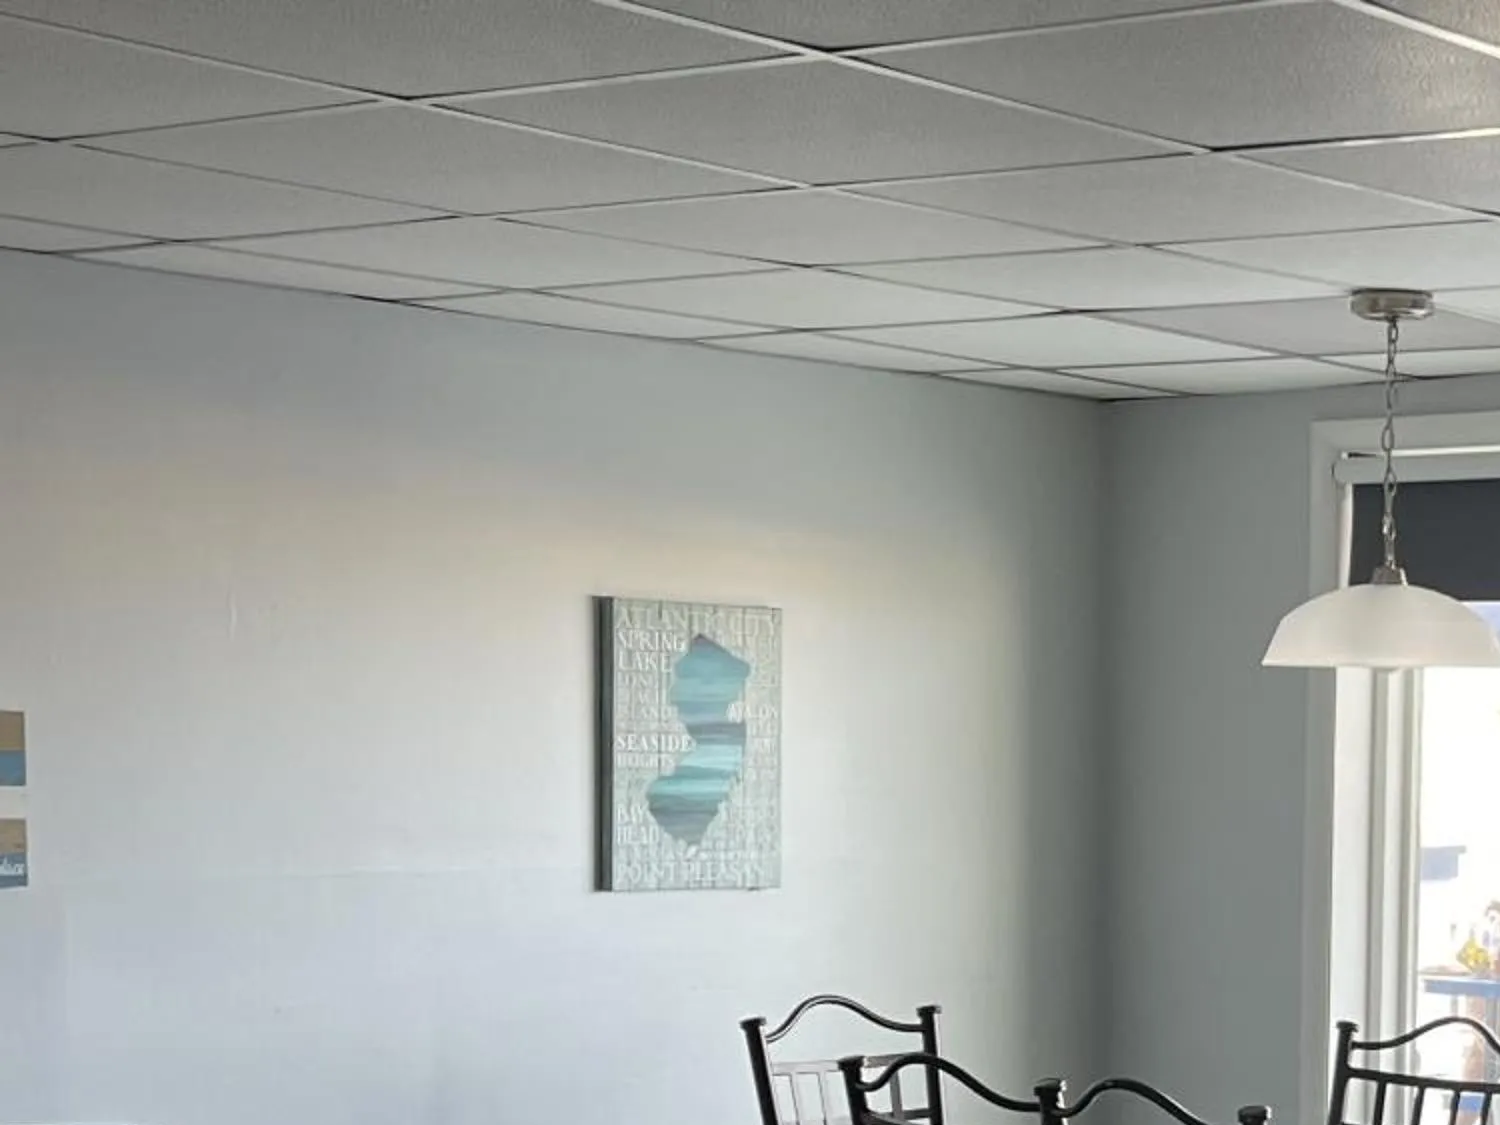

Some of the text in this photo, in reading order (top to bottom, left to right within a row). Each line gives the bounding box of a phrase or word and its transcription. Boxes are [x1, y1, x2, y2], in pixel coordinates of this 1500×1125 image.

[617, 630, 686, 652] SPRING
[618, 651, 672, 673] LAKE
[616, 733, 692, 752] SEASIDE
